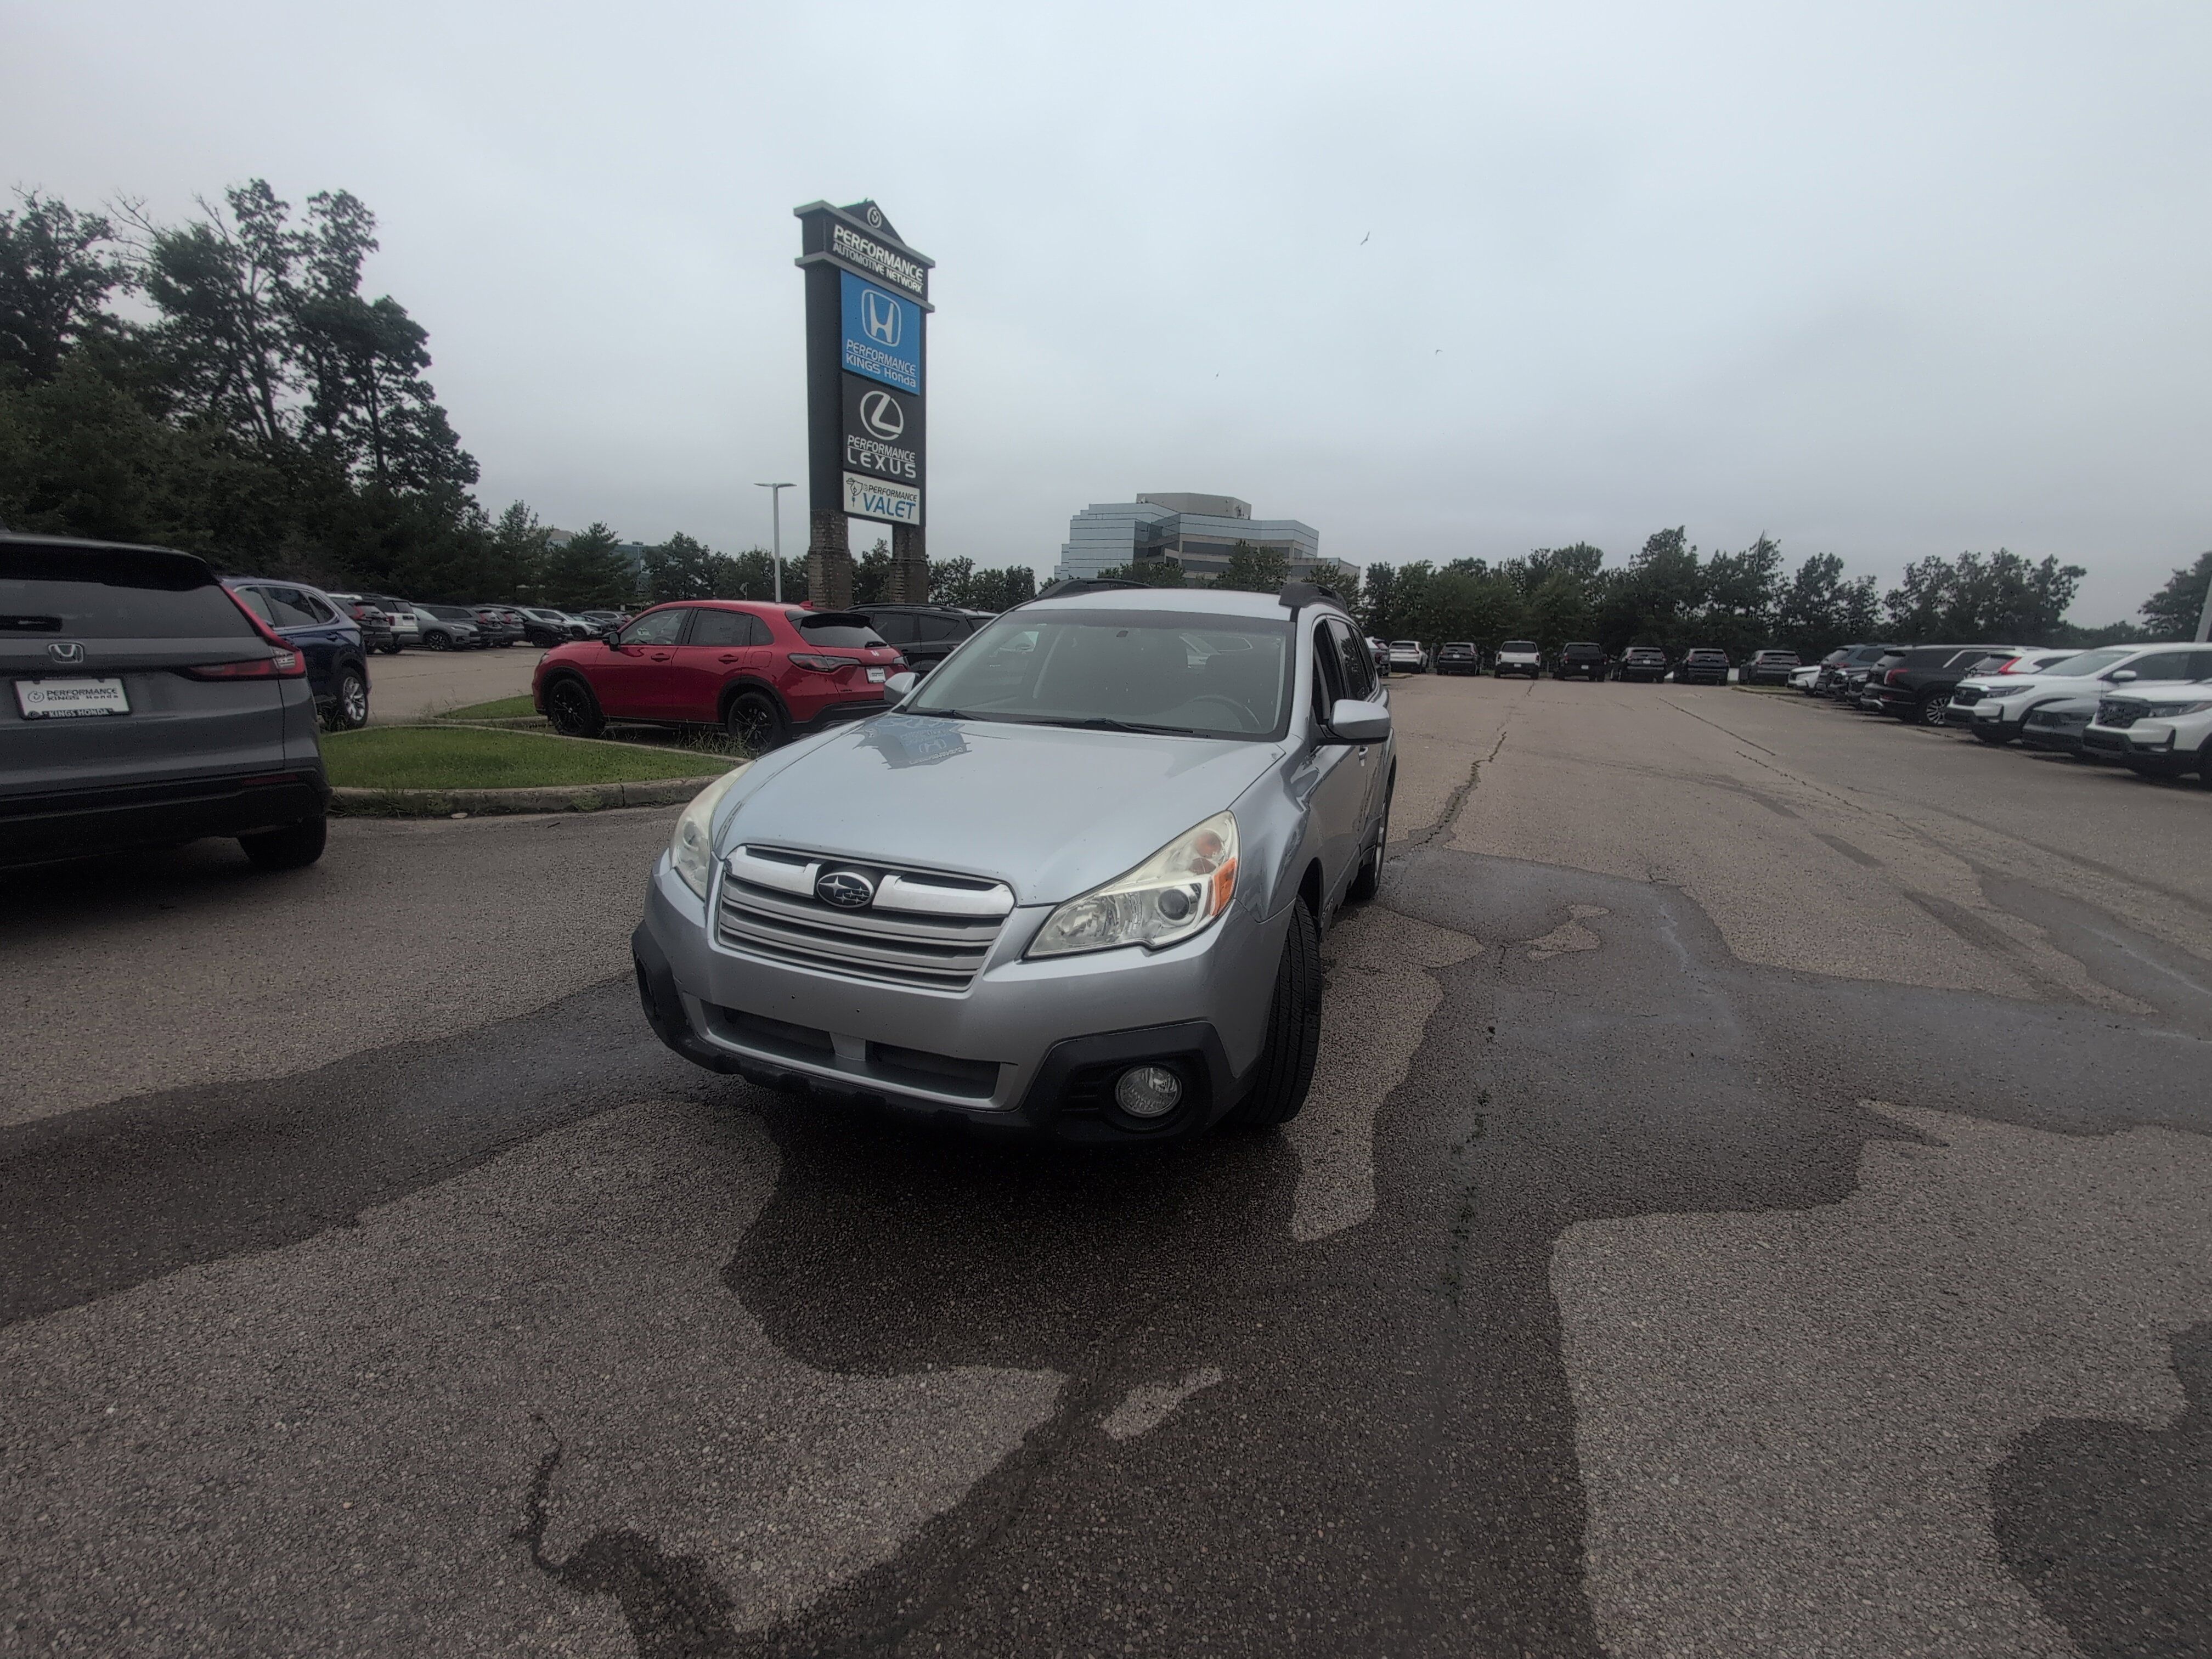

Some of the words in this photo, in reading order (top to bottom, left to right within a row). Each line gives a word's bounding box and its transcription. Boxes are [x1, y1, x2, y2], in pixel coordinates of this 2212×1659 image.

[834, 224, 923, 281] PERFORMANCE
[833, 242, 884, 275] AUTOMOTIVE
[887, 268, 922, 294] NETWORK
[846, 339, 916, 375] PERFORMANCE
[846, 354, 881, 374] KINGS
[884, 369, 916, 387] Honda
[847, 435, 916, 462] PERFORMANCE
[847, 448, 916, 478] LEXUS
[863, 493, 916, 519] VALET
[868, 484, 917, 502] PERFORMANCE
[47, 688, 117, 696] PERFORMANCE
